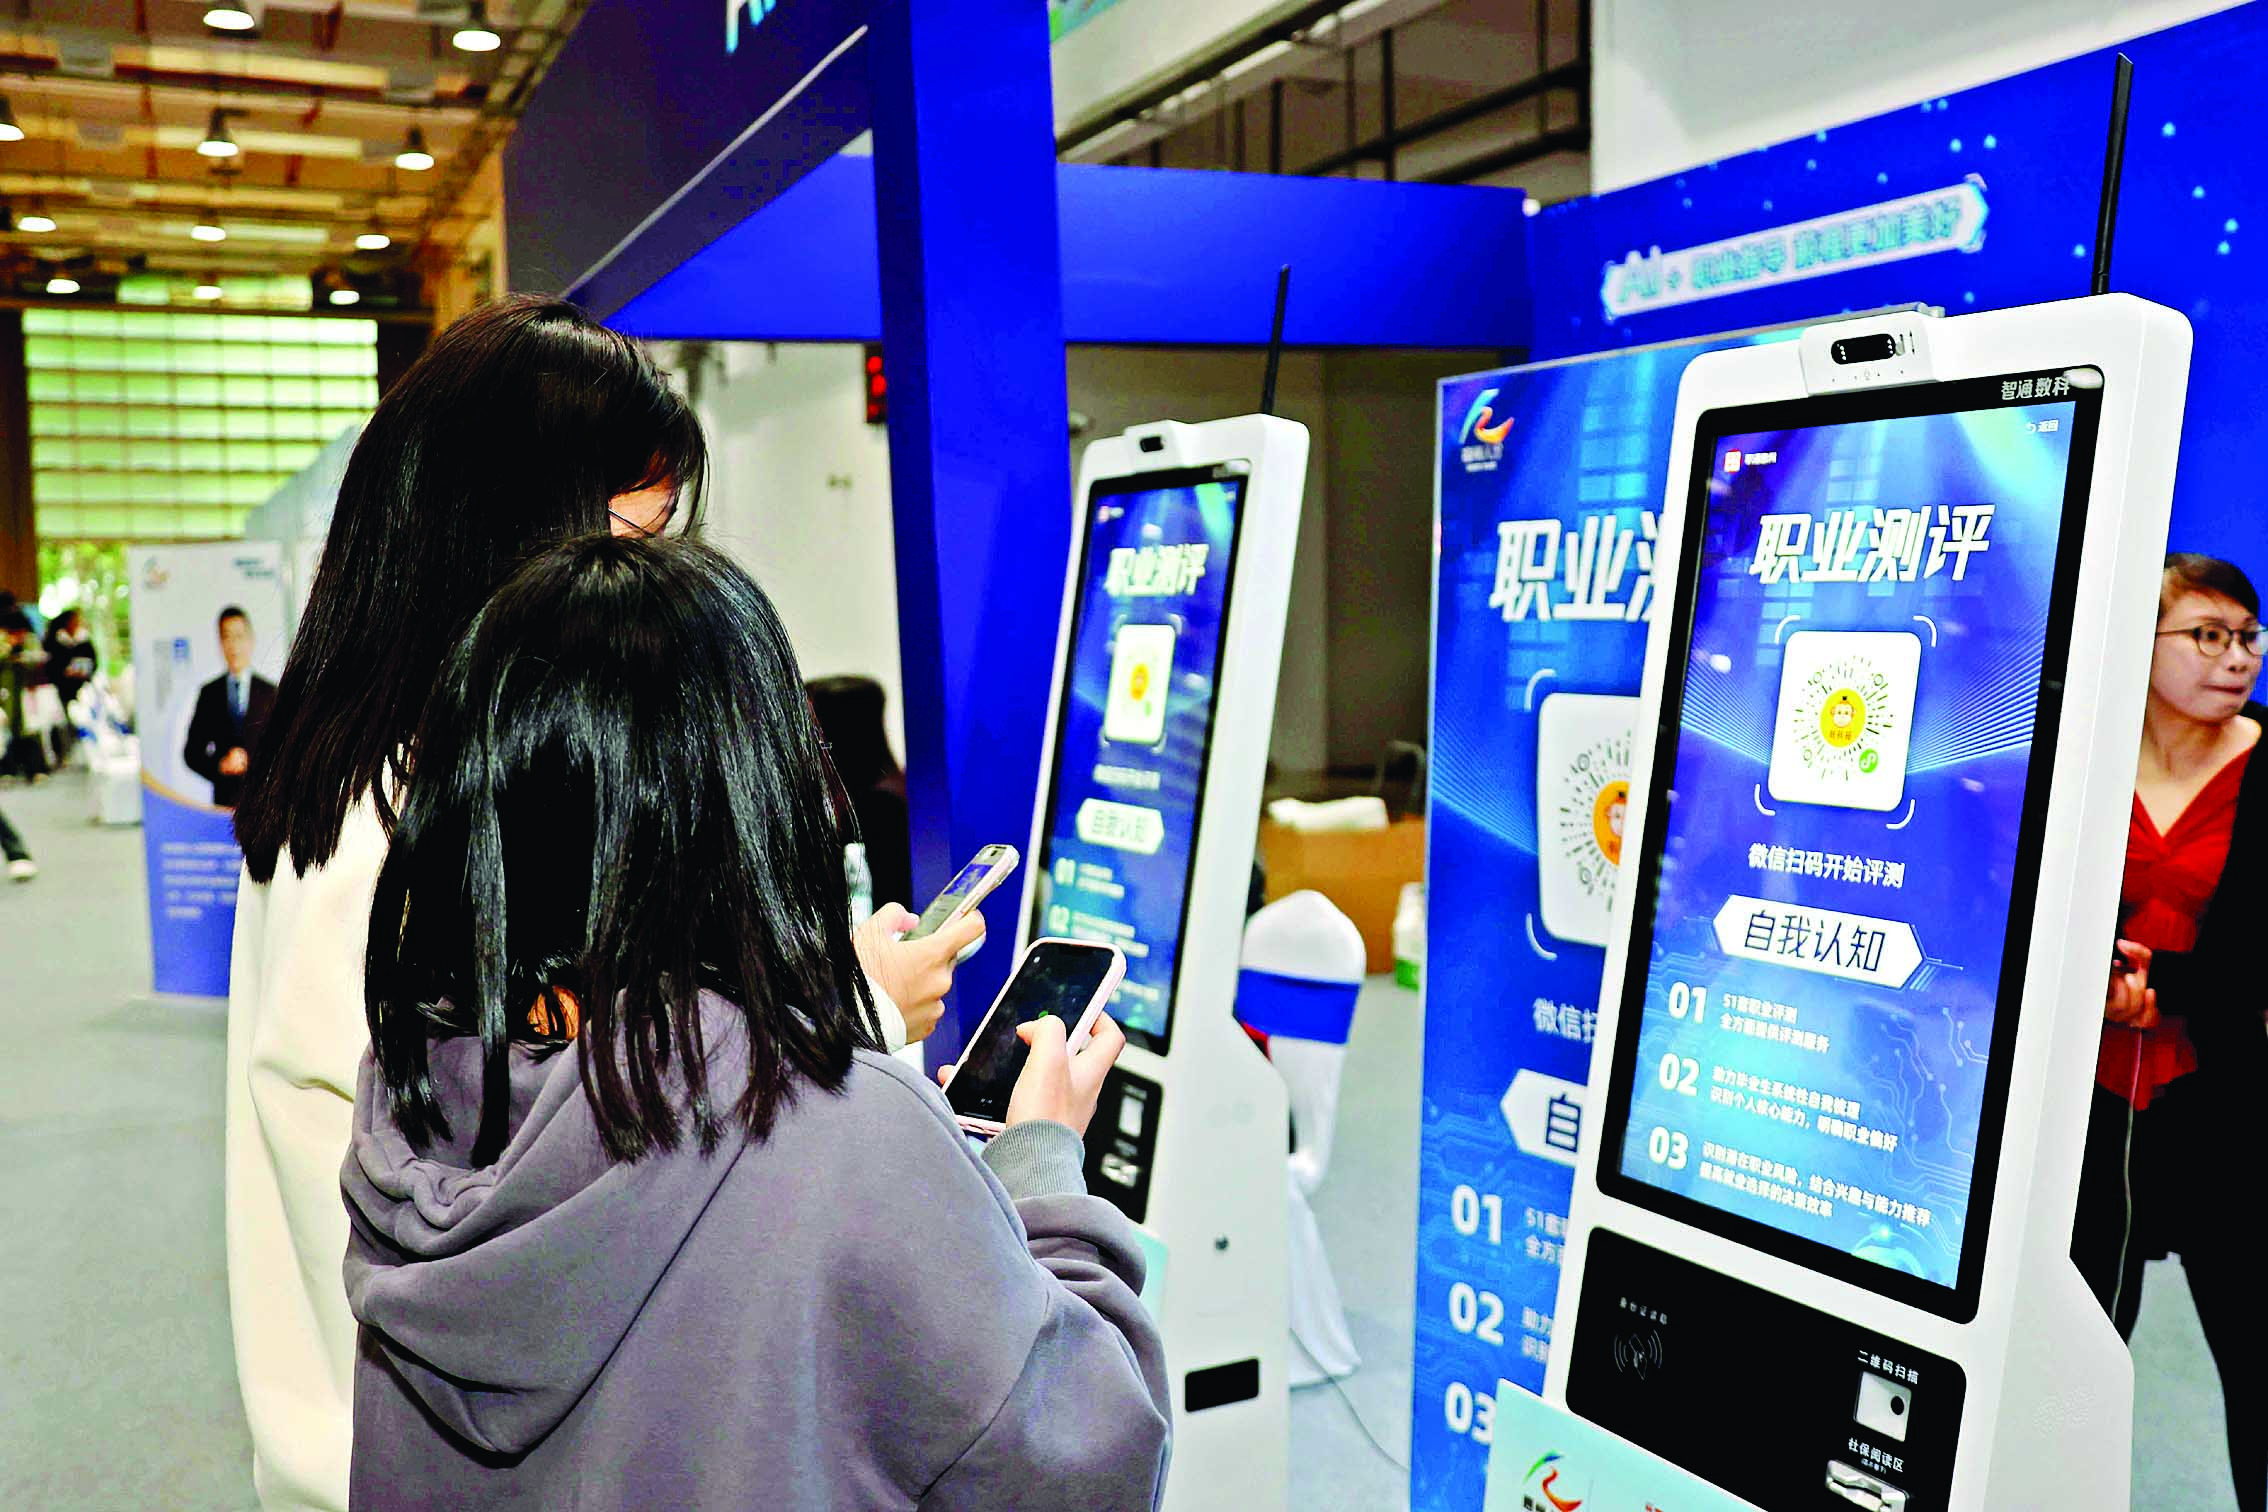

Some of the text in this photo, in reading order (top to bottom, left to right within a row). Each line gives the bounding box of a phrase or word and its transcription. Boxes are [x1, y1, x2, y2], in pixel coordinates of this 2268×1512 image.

[2001, 376, 2070, 401] 智通数科
[1750, 505, 1995, 584] 职业测评
[1749, 843, 1905, 888] 微信扫码开始评测
[1745, 909, 1886, 972] 自我认知
[1668, 981, 1707, 1024] 01
[1659, 1053, 1700, 1097] 02
[1546, 1093, 1581, 1153] 自
[1648, 1126, 1689, 1169] 03
[1452, 1184, 1502, 1245] 01
[1449, 1281, 1504, 1346] 02
[1857, 1350, 1919, 1385] 二维码扫描
[1445, 1382, 1496, 1446] 03
[1848, 1437, 1905, 1473] 社保阅读区
